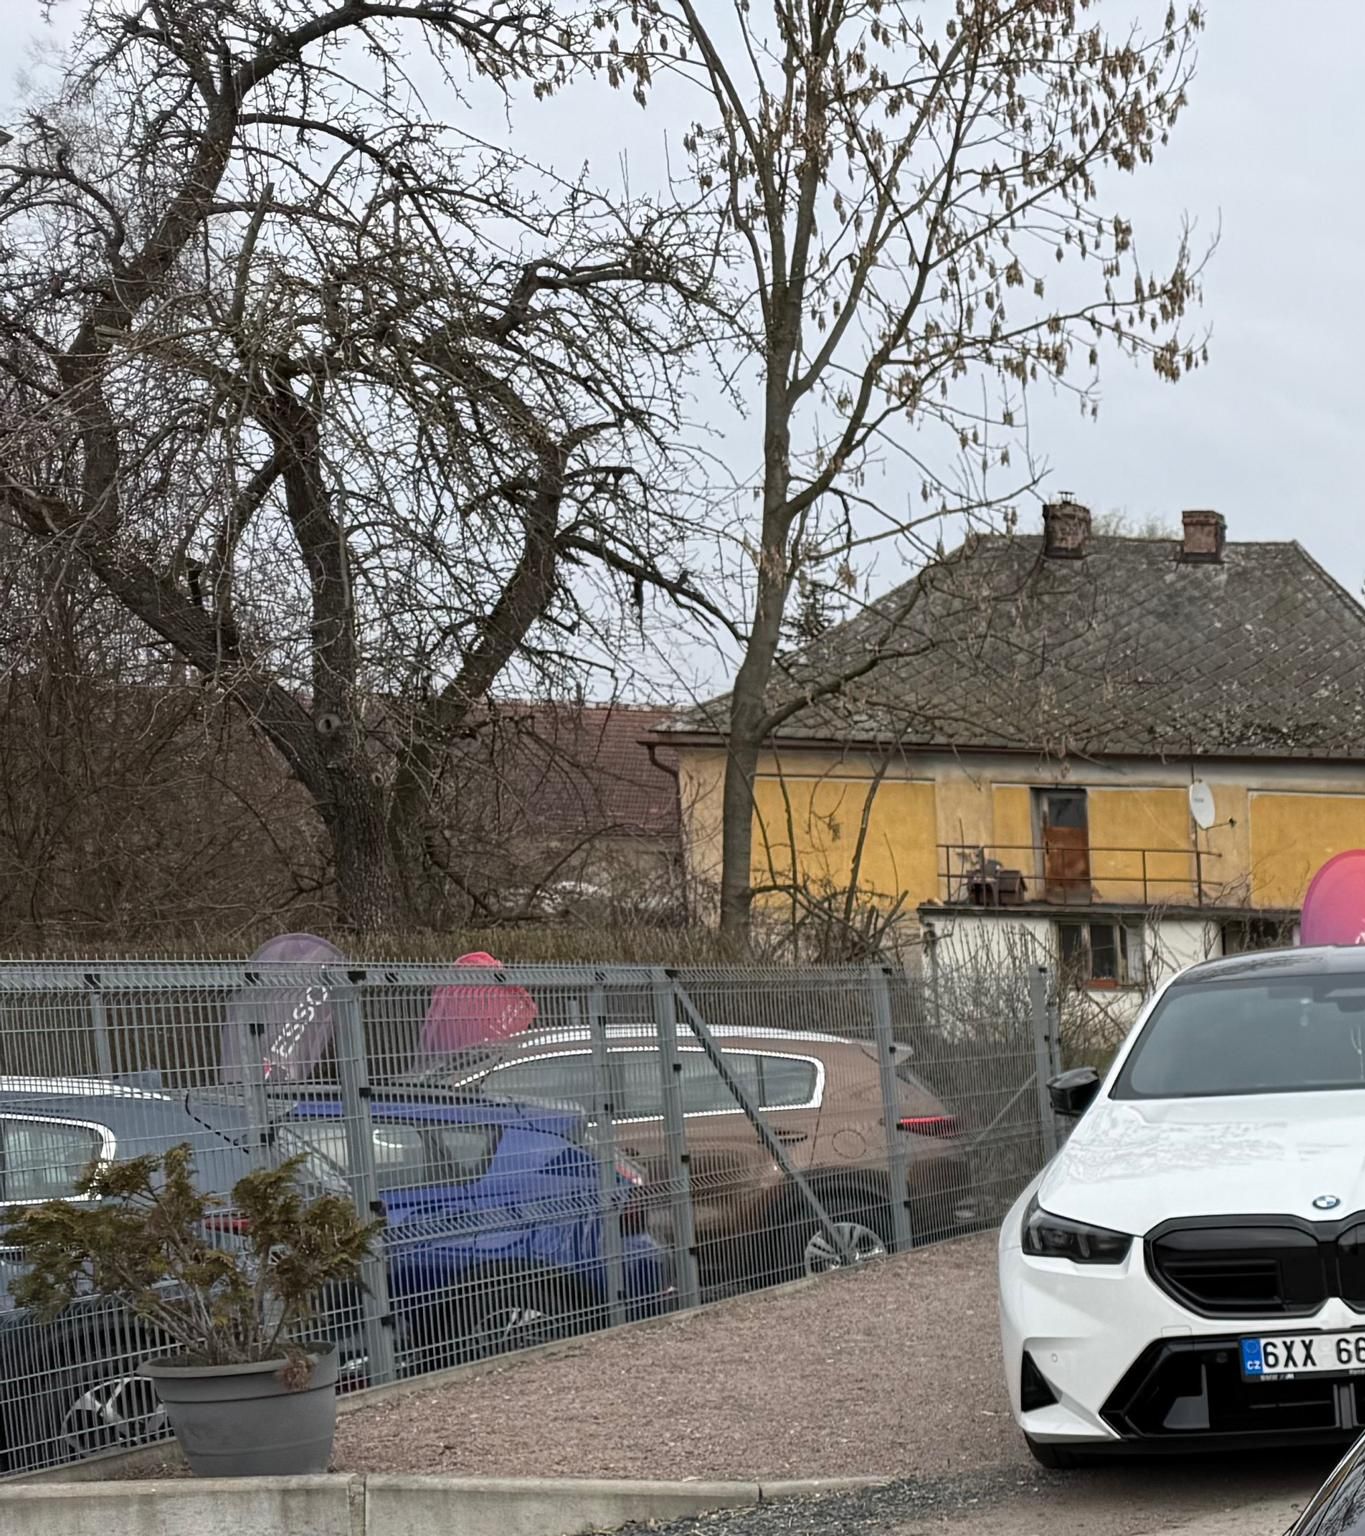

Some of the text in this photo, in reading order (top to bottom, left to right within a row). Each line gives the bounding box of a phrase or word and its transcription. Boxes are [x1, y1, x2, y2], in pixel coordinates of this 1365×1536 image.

[271, 980, 332, 1058] ESSO
[1247, 1361, 1261, 1370] CZ
[1262, 1339, 1317, 1368] 6XX
